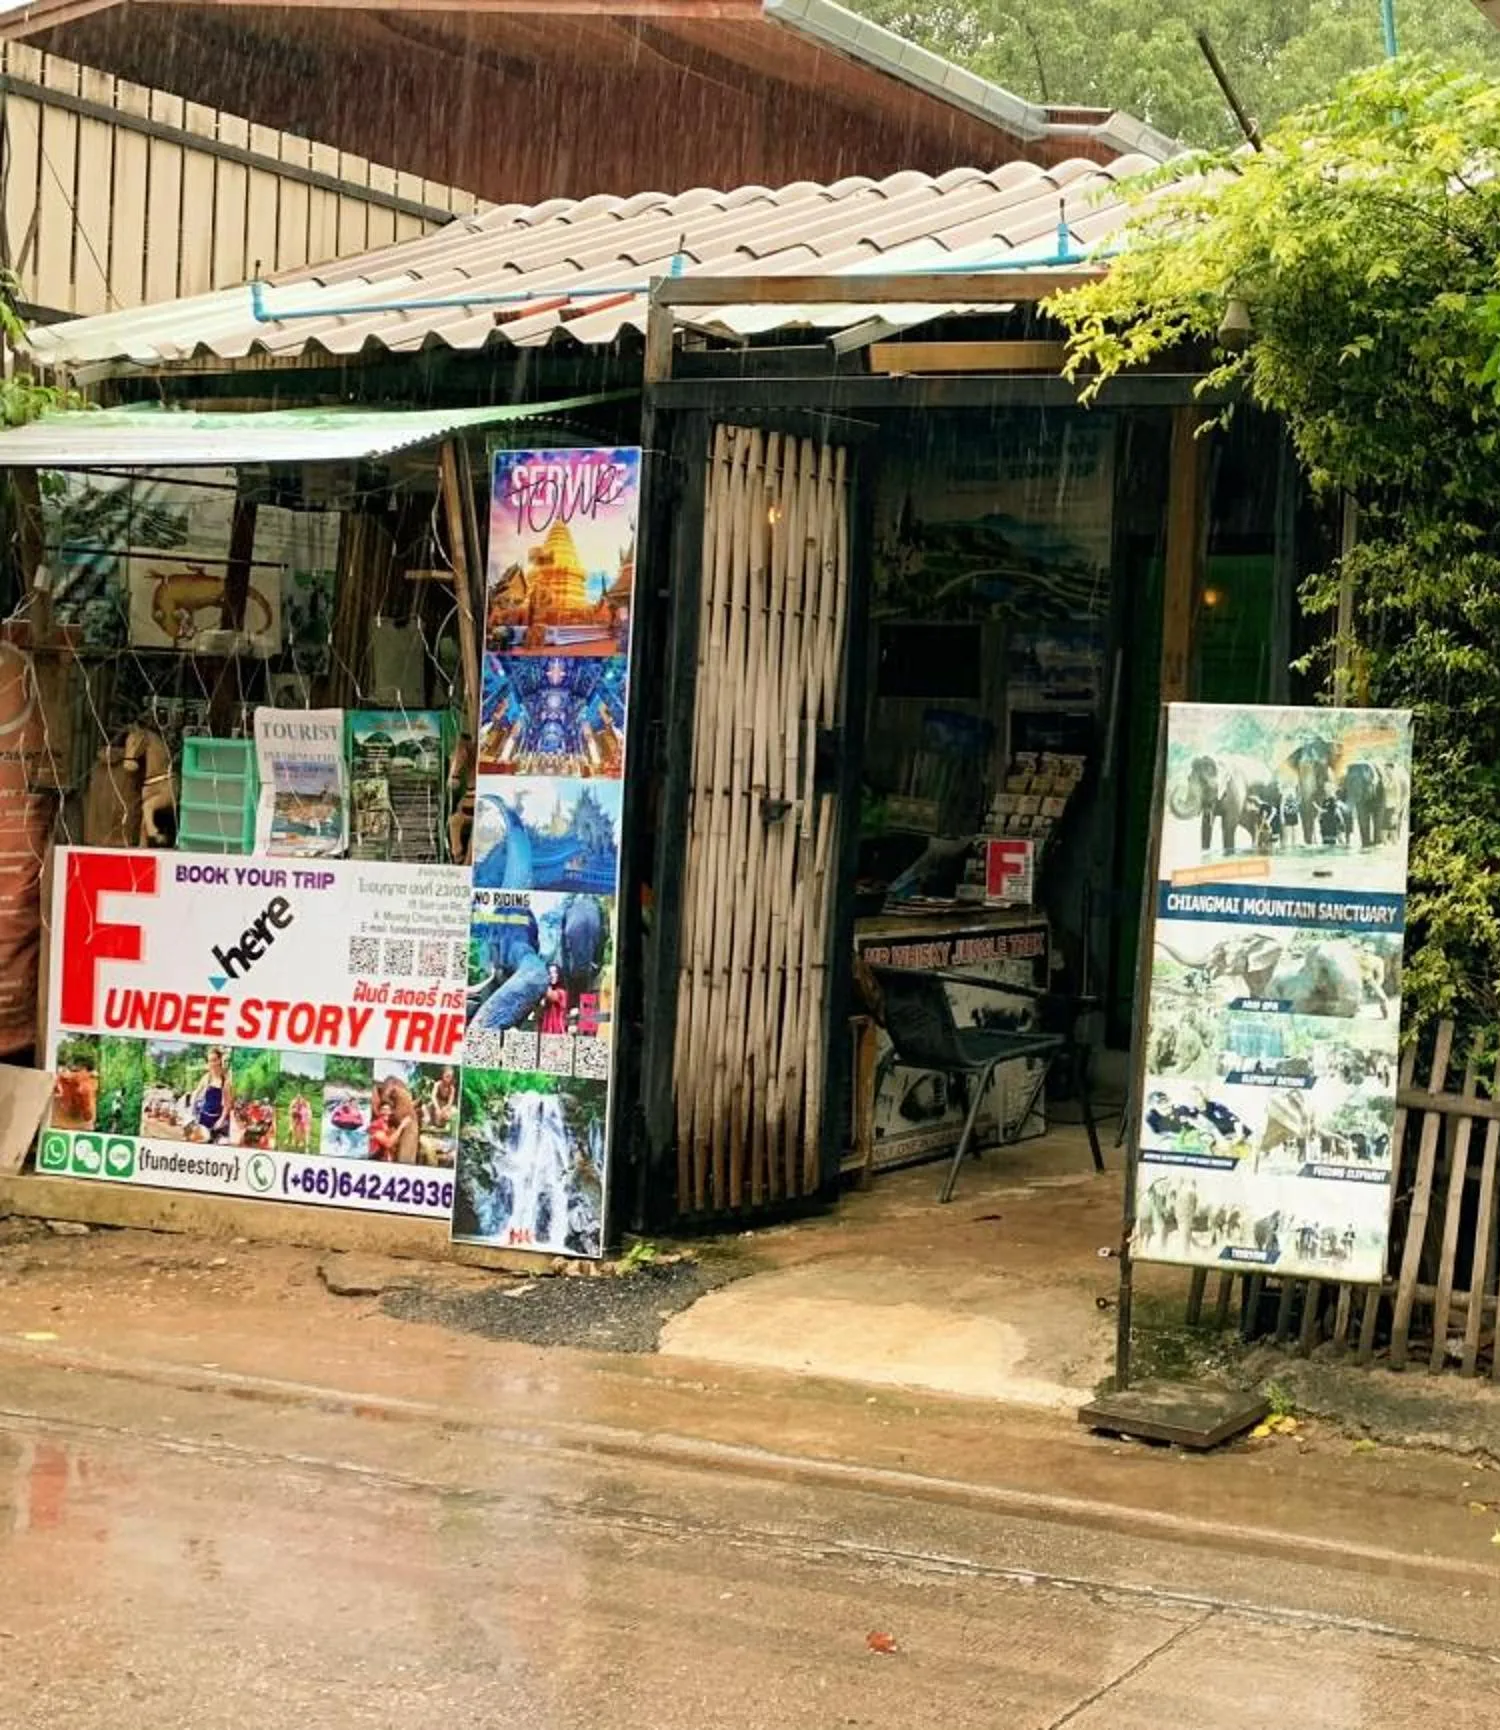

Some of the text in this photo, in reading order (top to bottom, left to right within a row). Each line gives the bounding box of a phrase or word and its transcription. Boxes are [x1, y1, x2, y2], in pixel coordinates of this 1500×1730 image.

[262, 722, 338, 741] TOURIST
[175, 865, 335, 889] BOOK YOUR TRIP
[987, 841, 1026, 896] F
[474, 892, 490, 906] NO
[1167, 893, 1397, 924] CHIANGMAI MOUNTAIN SANCTUARY
[211, 895, 295, 979] here
[440, 987, 464, 1009] ทริ
[236, 998, 374, 1048] STORY
